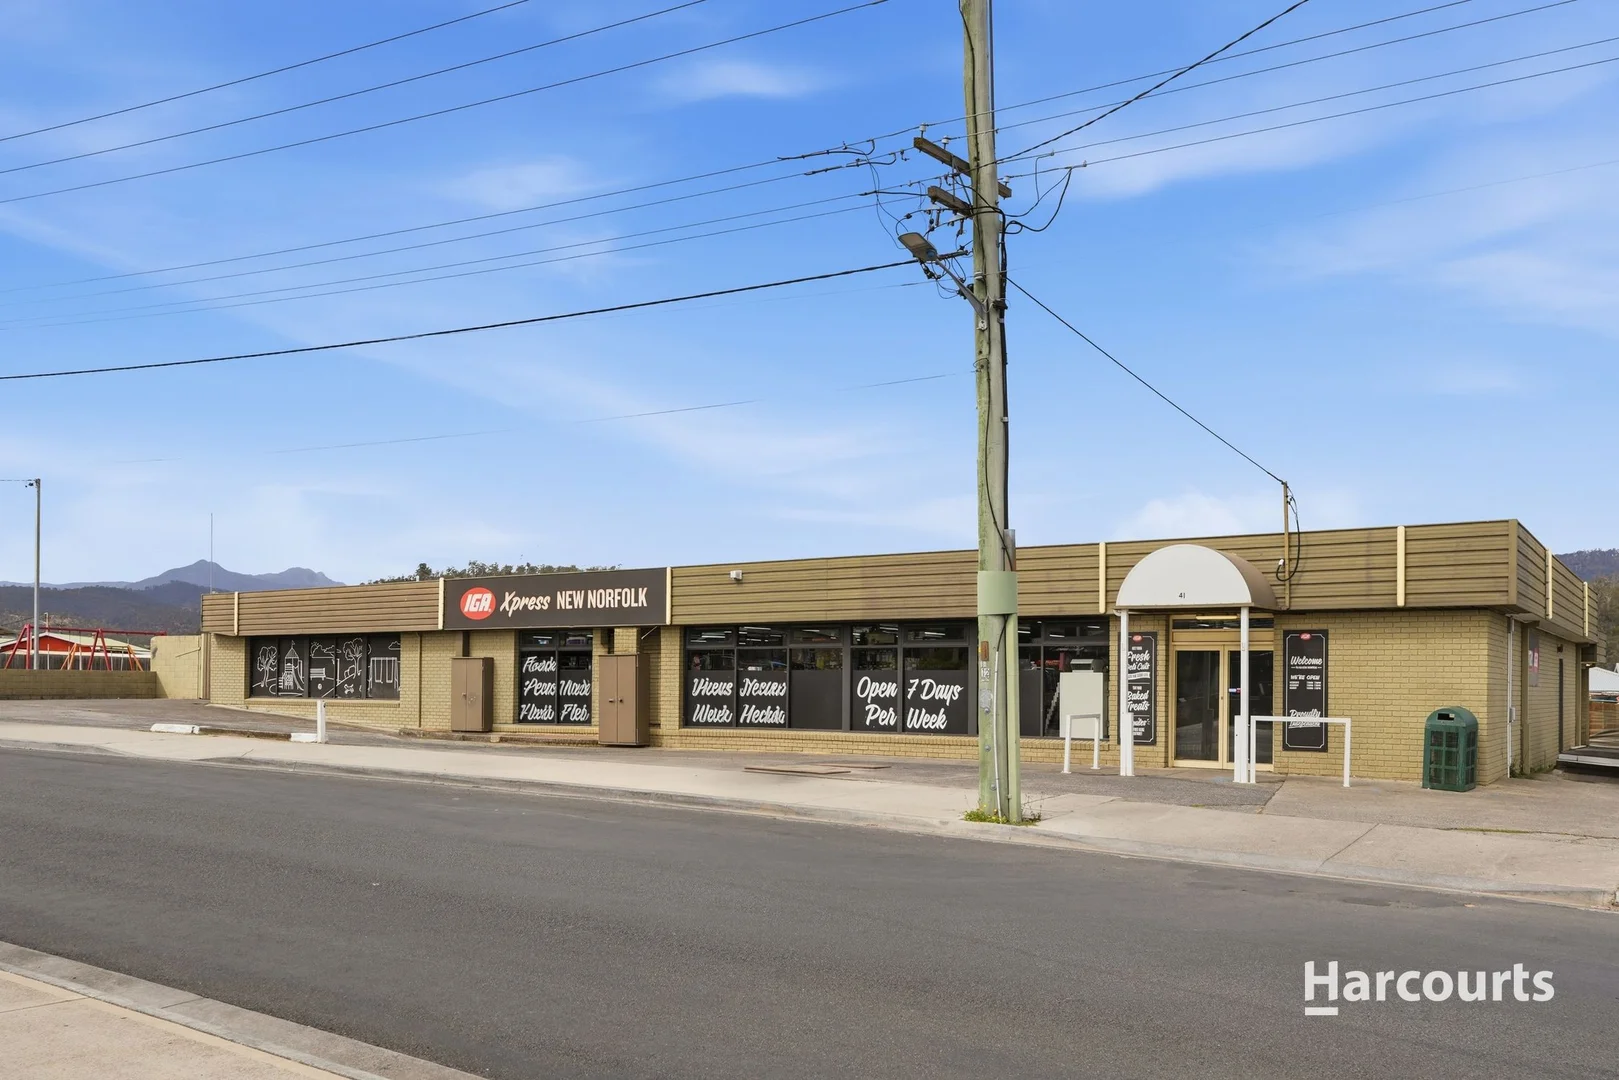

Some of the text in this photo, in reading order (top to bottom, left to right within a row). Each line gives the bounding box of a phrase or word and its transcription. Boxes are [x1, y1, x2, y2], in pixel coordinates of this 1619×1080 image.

[464, 587, 648, 617] IGA Xpress NEW NORFOLK
[1290, 656, 1322, 665] Welcome
[857, 676, 964, 706] Open 7 Days
[865, 703, 947, 730] Per Week
